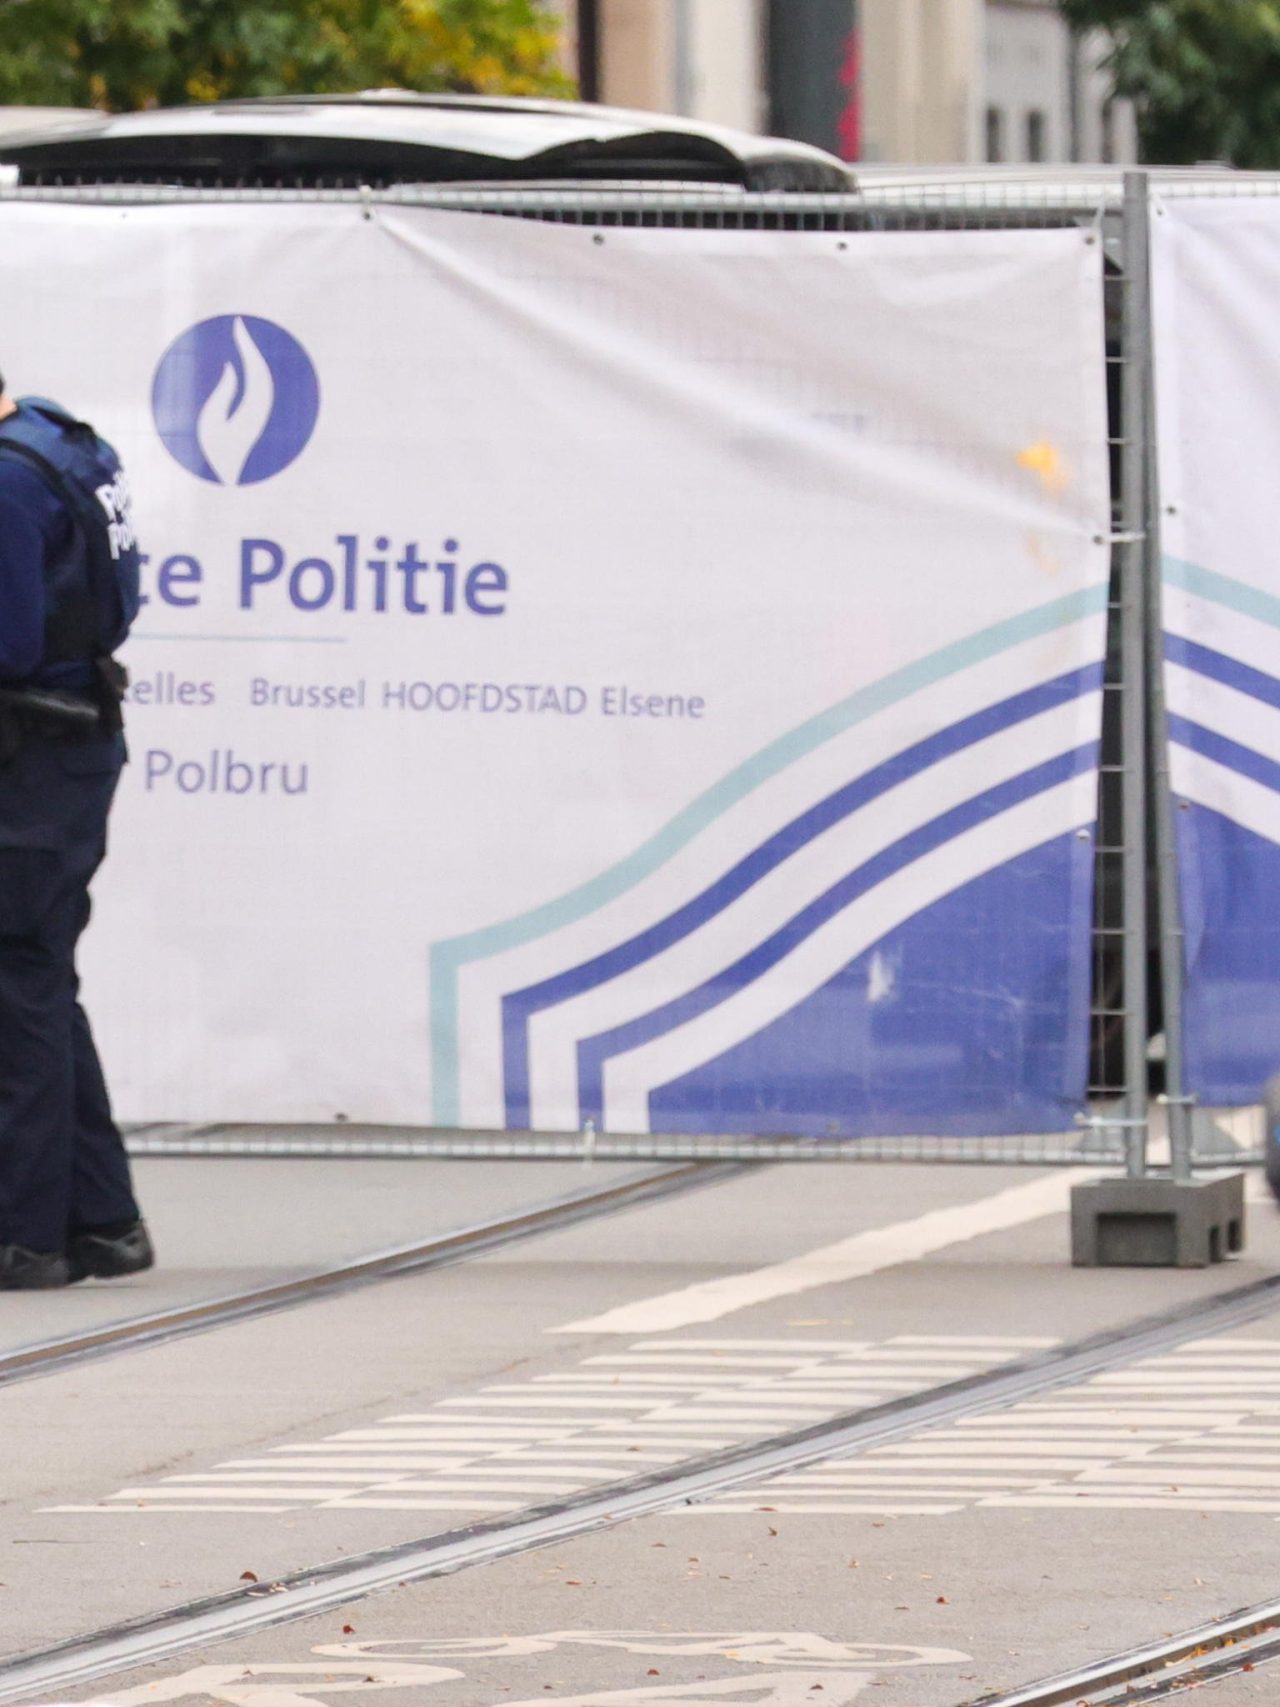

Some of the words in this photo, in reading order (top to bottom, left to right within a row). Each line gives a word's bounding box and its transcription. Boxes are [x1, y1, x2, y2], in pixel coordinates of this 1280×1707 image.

[239, 534, 508, 616] Politie
[121, 671, 216, 706] elles
[250, 677, 367, 709] Brussel
[381, 680, 588, 716] HOOFDSTAD
[600, 685, 706, 719] Elsene
[144, 748, 309, 795] Polbru
